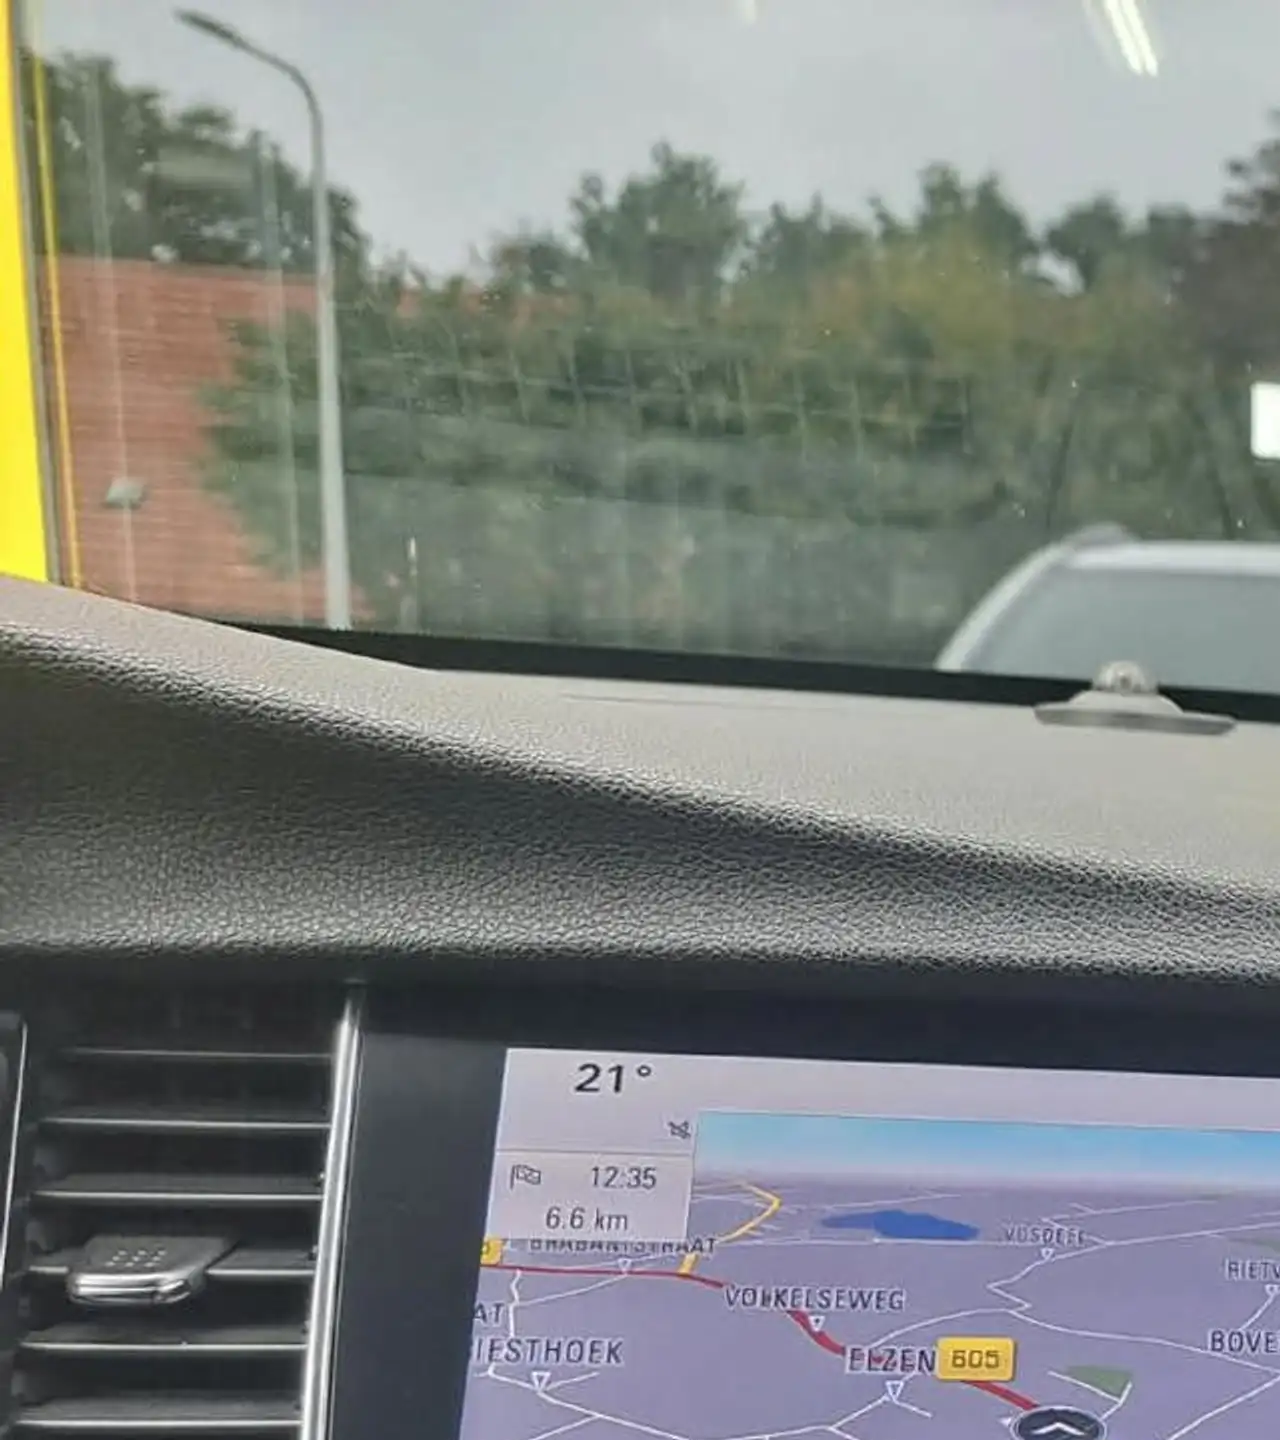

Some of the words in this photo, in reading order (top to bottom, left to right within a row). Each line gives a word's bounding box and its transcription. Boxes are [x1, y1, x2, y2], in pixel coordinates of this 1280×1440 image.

[575, 1063, 653, 1094] 21°
[591, 1165, 657, 1190] 12:35
[545, 1205, 586, 1231] 6.6
[595, 1207, 629, 1232] km
[849, 1347, 936, 1373] ELZEN
[951, 1349, 1001, 1369] 605
